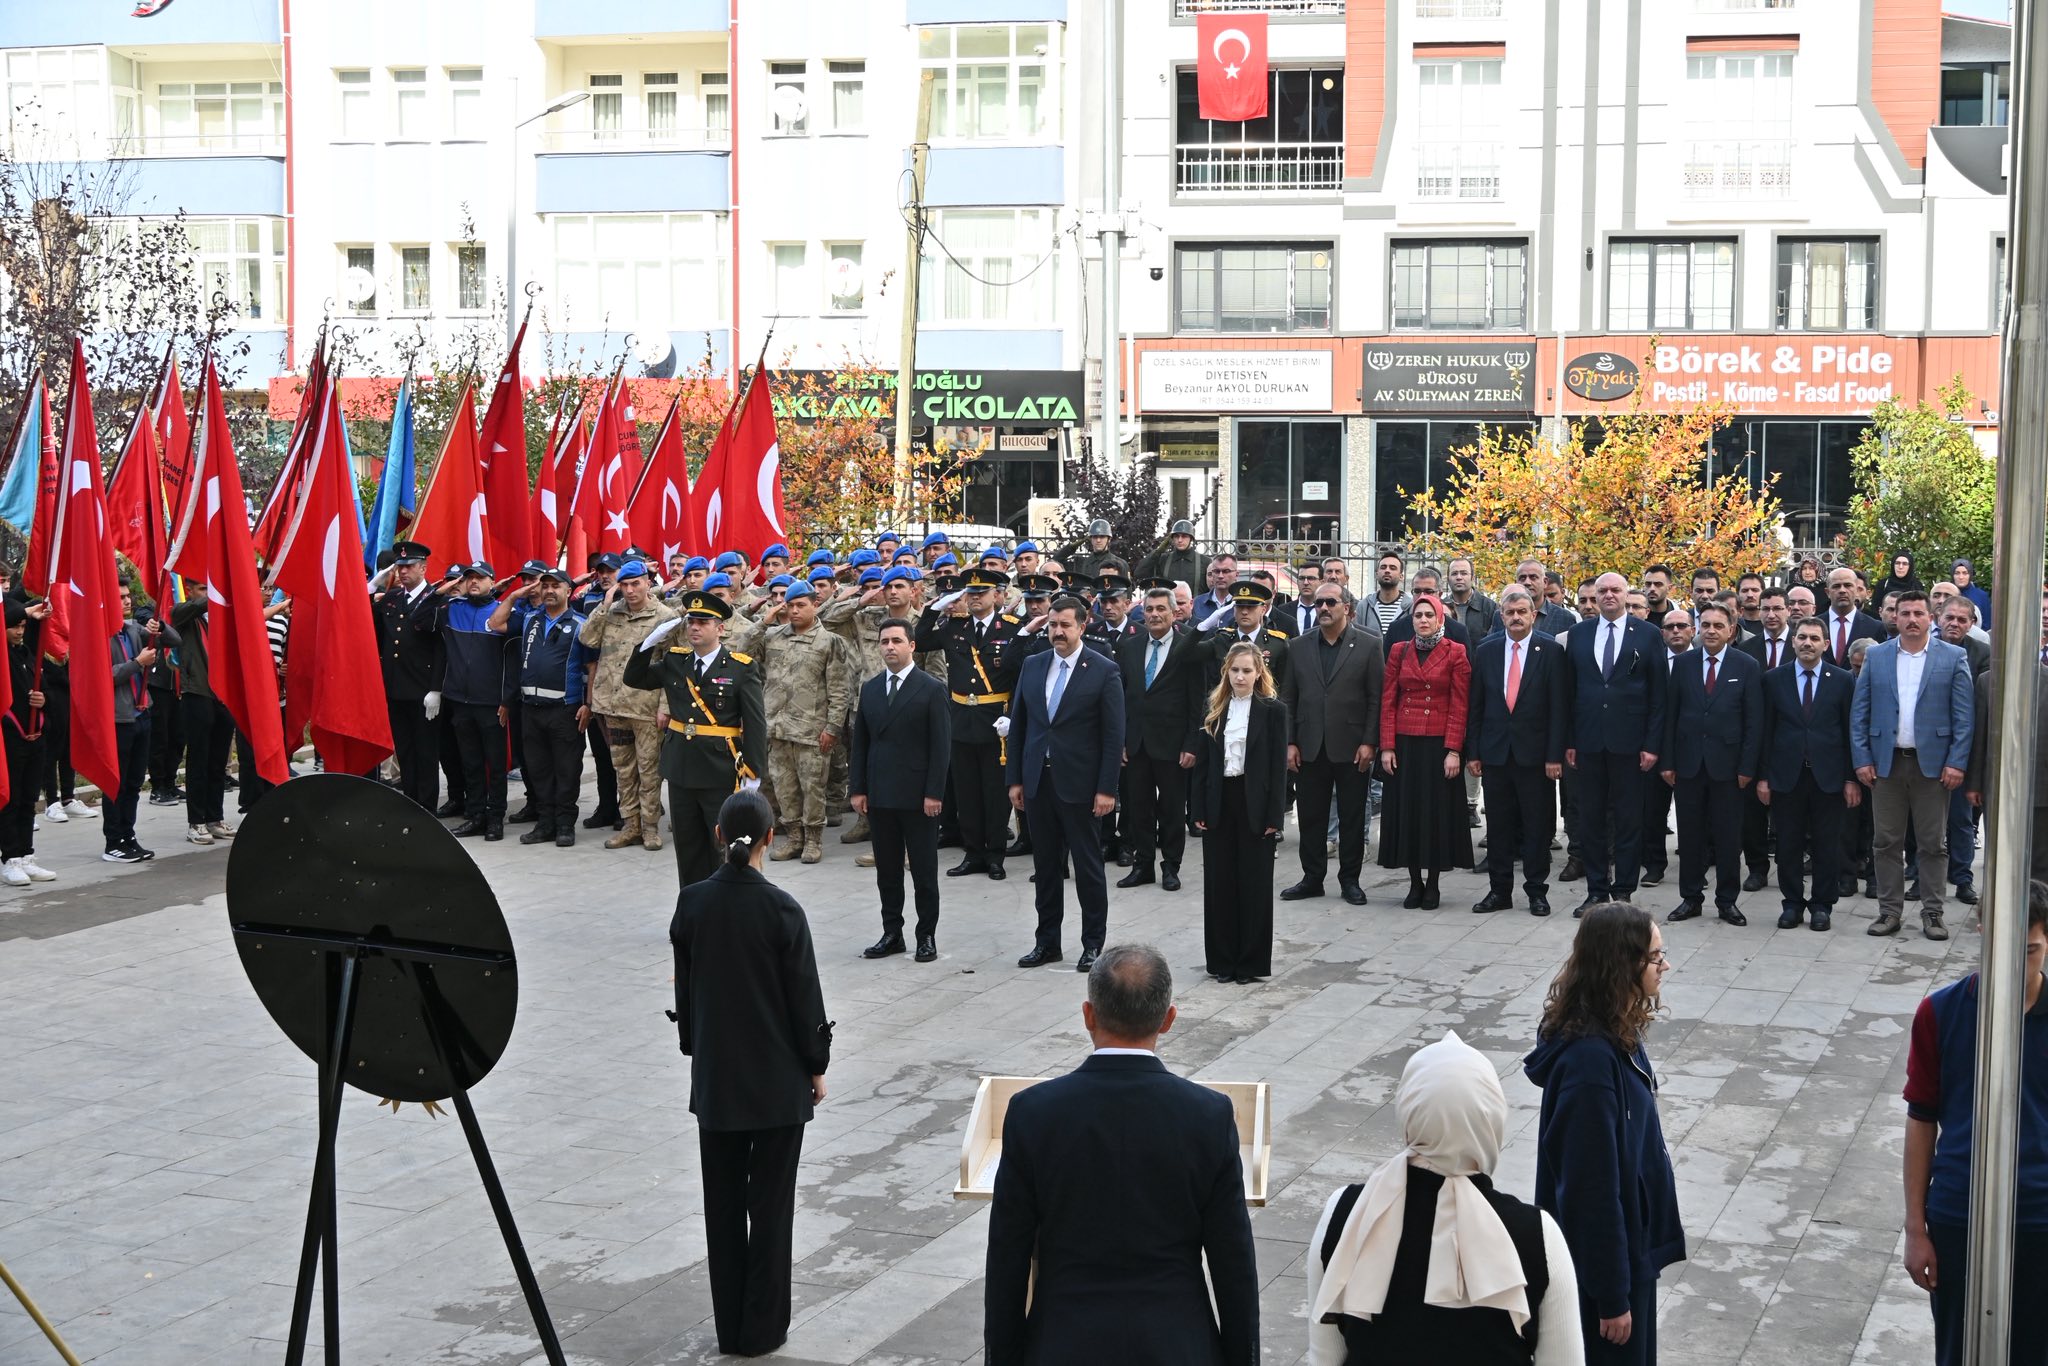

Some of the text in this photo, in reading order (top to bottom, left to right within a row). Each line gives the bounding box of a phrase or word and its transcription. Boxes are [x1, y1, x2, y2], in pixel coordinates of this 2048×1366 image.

[1216, 358, 1254, 366] MESLEK
[1395, 355, 1503, 367] ZEREN HUKUK
[1655, 346, 1892, 374] Börek & Pide
[1417, 371, 1478, 385] BÜROSU
[1164, 383, 1309, 395] Beyzanur AKYOL DURUKAN
[1374, 389, 1523, 401] AV. SÜLEYMAN ZEREN
[1653, 381, 1708, 402] Pestil
[1724, 381, 1778, 402] Köme
[1794, 381, 1840, 402] Fasd
[1845, 381, 1892, 402] Food
[923, 391, 1078, 426] ÇİKOLATA
[523, 620, 540, 669] ZABITA
